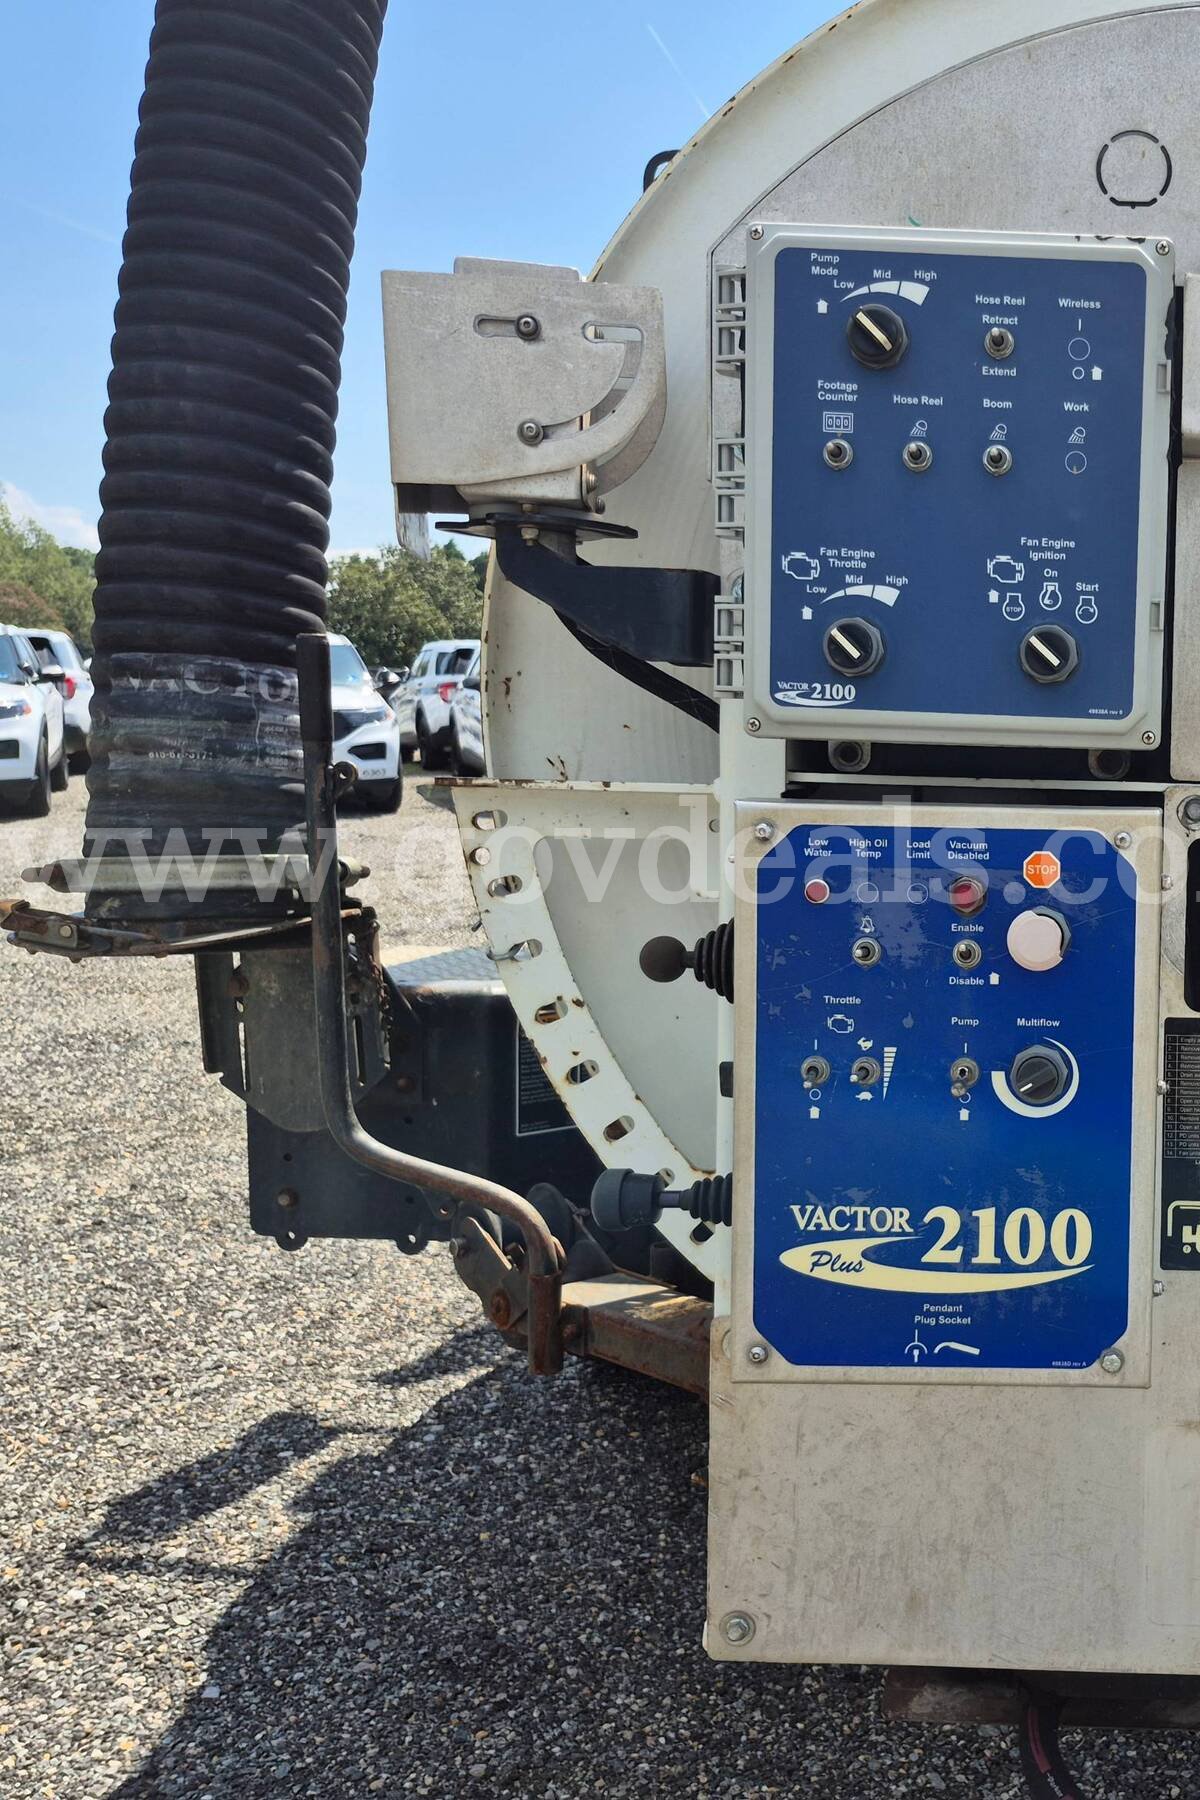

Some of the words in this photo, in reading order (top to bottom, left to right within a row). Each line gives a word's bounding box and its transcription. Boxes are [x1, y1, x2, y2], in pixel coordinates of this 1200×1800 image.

[810, 253, 839, 265] Pump
[811, 266, 838, 277] Mode
[834, 279, 854, 289] Low
[873, 269, 891, 279] Mid
[914, 270, 937, 282] High
[975, 295, 1000, 305] Hose
[1003, 296, 1025, 306] Reel
[1059, 299, 1101, 309] Wireless
[982, 315, 1017, 325] Retract
[982, 366, 1016, 377] Extend
[818, 381, 858, 392] Footage
[818, 391, 857, 402] Counter
[893, 395, 918, 405] Hose
[921, 396, 943, 406] Reel
[983, 399, 1012, 409] Boom
[1064, 402, 1089, 412] Work
[1021, 537, 1039, 547] Fan
[1043, 538, 1075, 549] Engine
[820, 547, 839, 557] Fan
[843, 549, 875, 560] Engine
[1029, 550, 1066, 561] Ignition
[828, 559, 866, 569] Throttle
[1044, 568, 1058, 578] On
[806, 585, 827, 594] Low
[845, 575, 863, 584] Mid
[886, 575, 908, 586] High
[1076, 582, 1099, 592] Start
[777, 681, 808, 690] VACTOR
[811, 683, 856, 700] 2100
[808, 837, 828, 847] Low
[849, 838, 869, 849] High
[872, 838, 887, 847] Oil
[906, 839, 930, 849] Load
[949, 841, 988, 851] Vacuum
[804, 847, 832, 857] Water
[856, 849, 881, 859] Temp
[906, 850, 930, 859] Limit
[948, 851, 989, 860] Disabled
[1027, 864, 1057, 876] STOP
[951, 923, 984, 932] Enable
[949, 976, 984, 986] Disable
[824, 995, 861, 1005] Throttle
[951, 1017, 979, 1027] Pump
[1017, 1017, 1060, 1028] Multiflow
[790, 1205, 913, 1232] VACTOR
[921, 1206, 1093, 1266] 2100
[810, 1250, 865, 1272] Plus
[923, 1304, 962, 1313] Pendant
[914, 1315, 936, 1326] Plug
[939, 1316, 971, 1325] Socket
